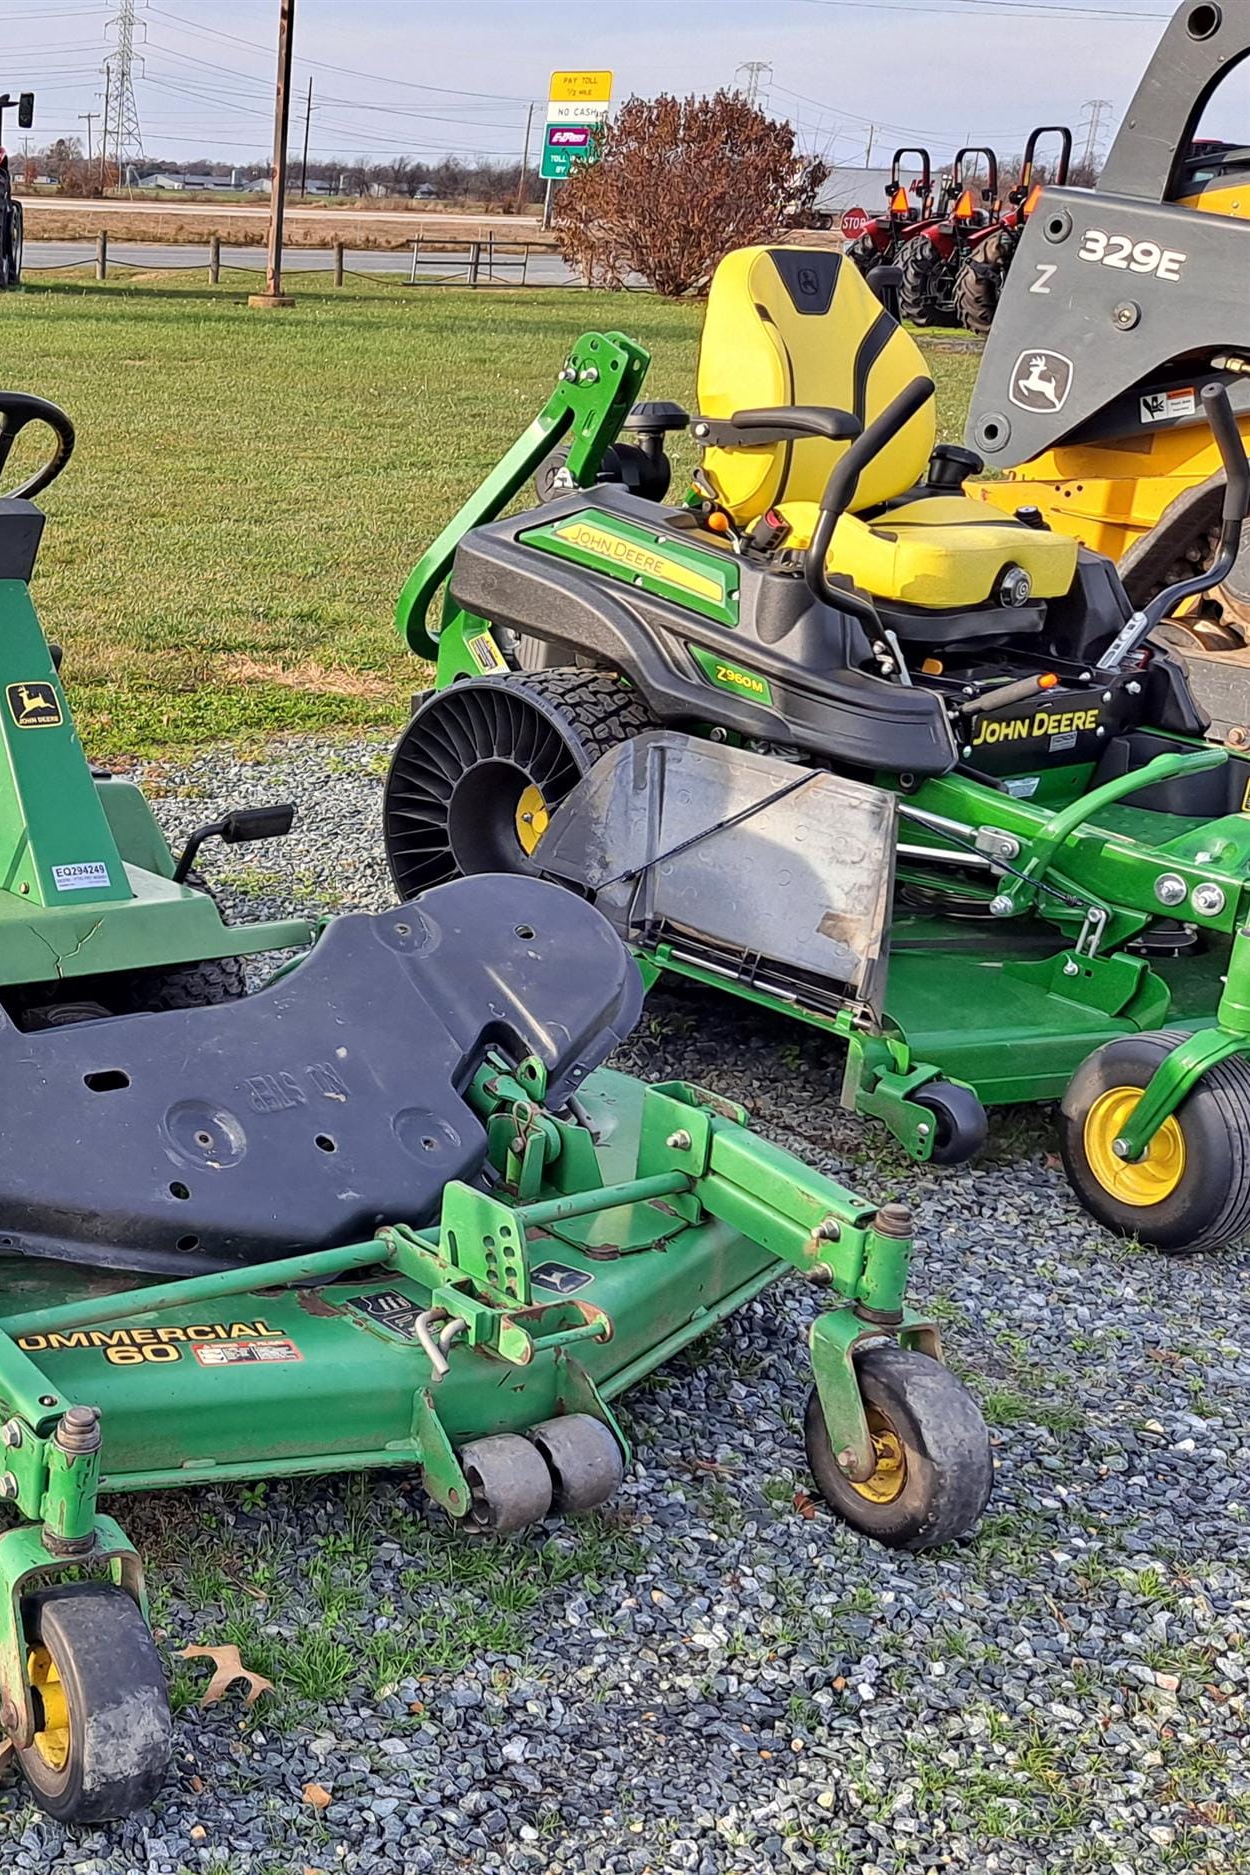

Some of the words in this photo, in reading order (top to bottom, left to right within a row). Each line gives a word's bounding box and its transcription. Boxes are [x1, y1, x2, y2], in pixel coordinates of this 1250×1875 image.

[556, 166, 566, 174] BY
[843, 217, 866, 229] STOP
[1079, 230, 1186, 282] 329E
[1029, 264, 1058, 294] Z
[572, 528, 613, 552] JOHN
[614, 542, 664, 574] DEERE
[716, 665, 763, 693] Z960M
[973, 719, 1030, 745] JOHN
[1031, 709, 1099, 737] DEERE
[55, 864, 105, 877] EQ294249
[18, 1321, 284, 1350] OMMERCIAL
[105, 1343, 180, 1364] 60
